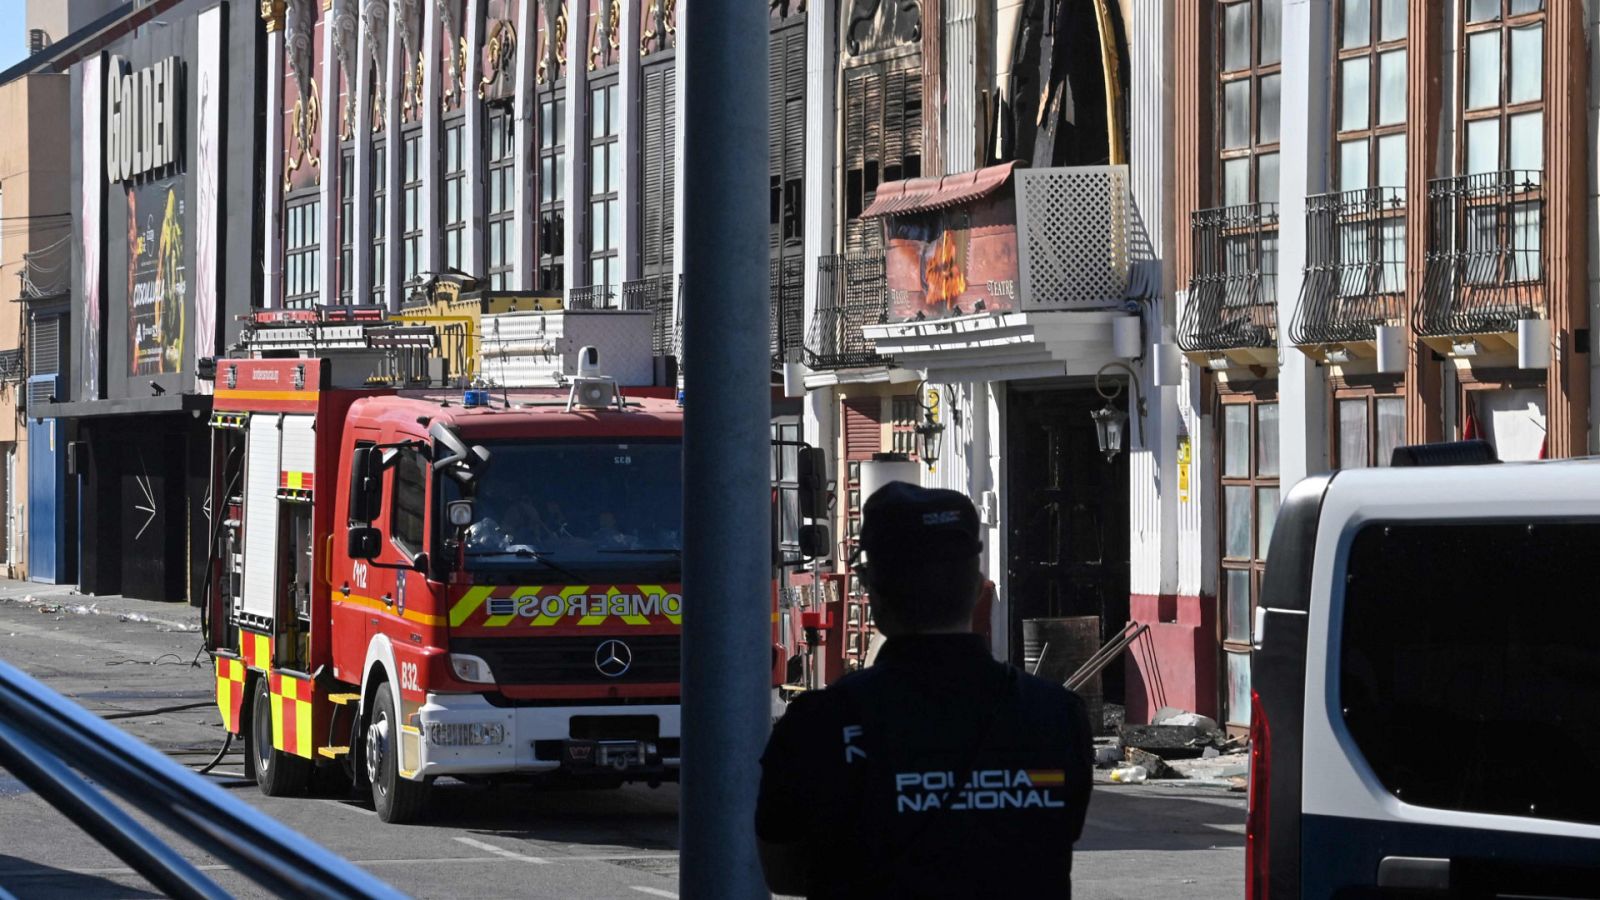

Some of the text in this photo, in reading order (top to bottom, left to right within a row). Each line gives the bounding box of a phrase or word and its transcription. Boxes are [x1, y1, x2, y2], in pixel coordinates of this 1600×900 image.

[107, 55, 176, 184] GOLDEN
[988, 280, 1014, 299] TEATRE
[355, 562, 367, 588] 112
[896, 769, 1033, 791] POLICIA
[898, 790, 1065, 813] NACIONAL
